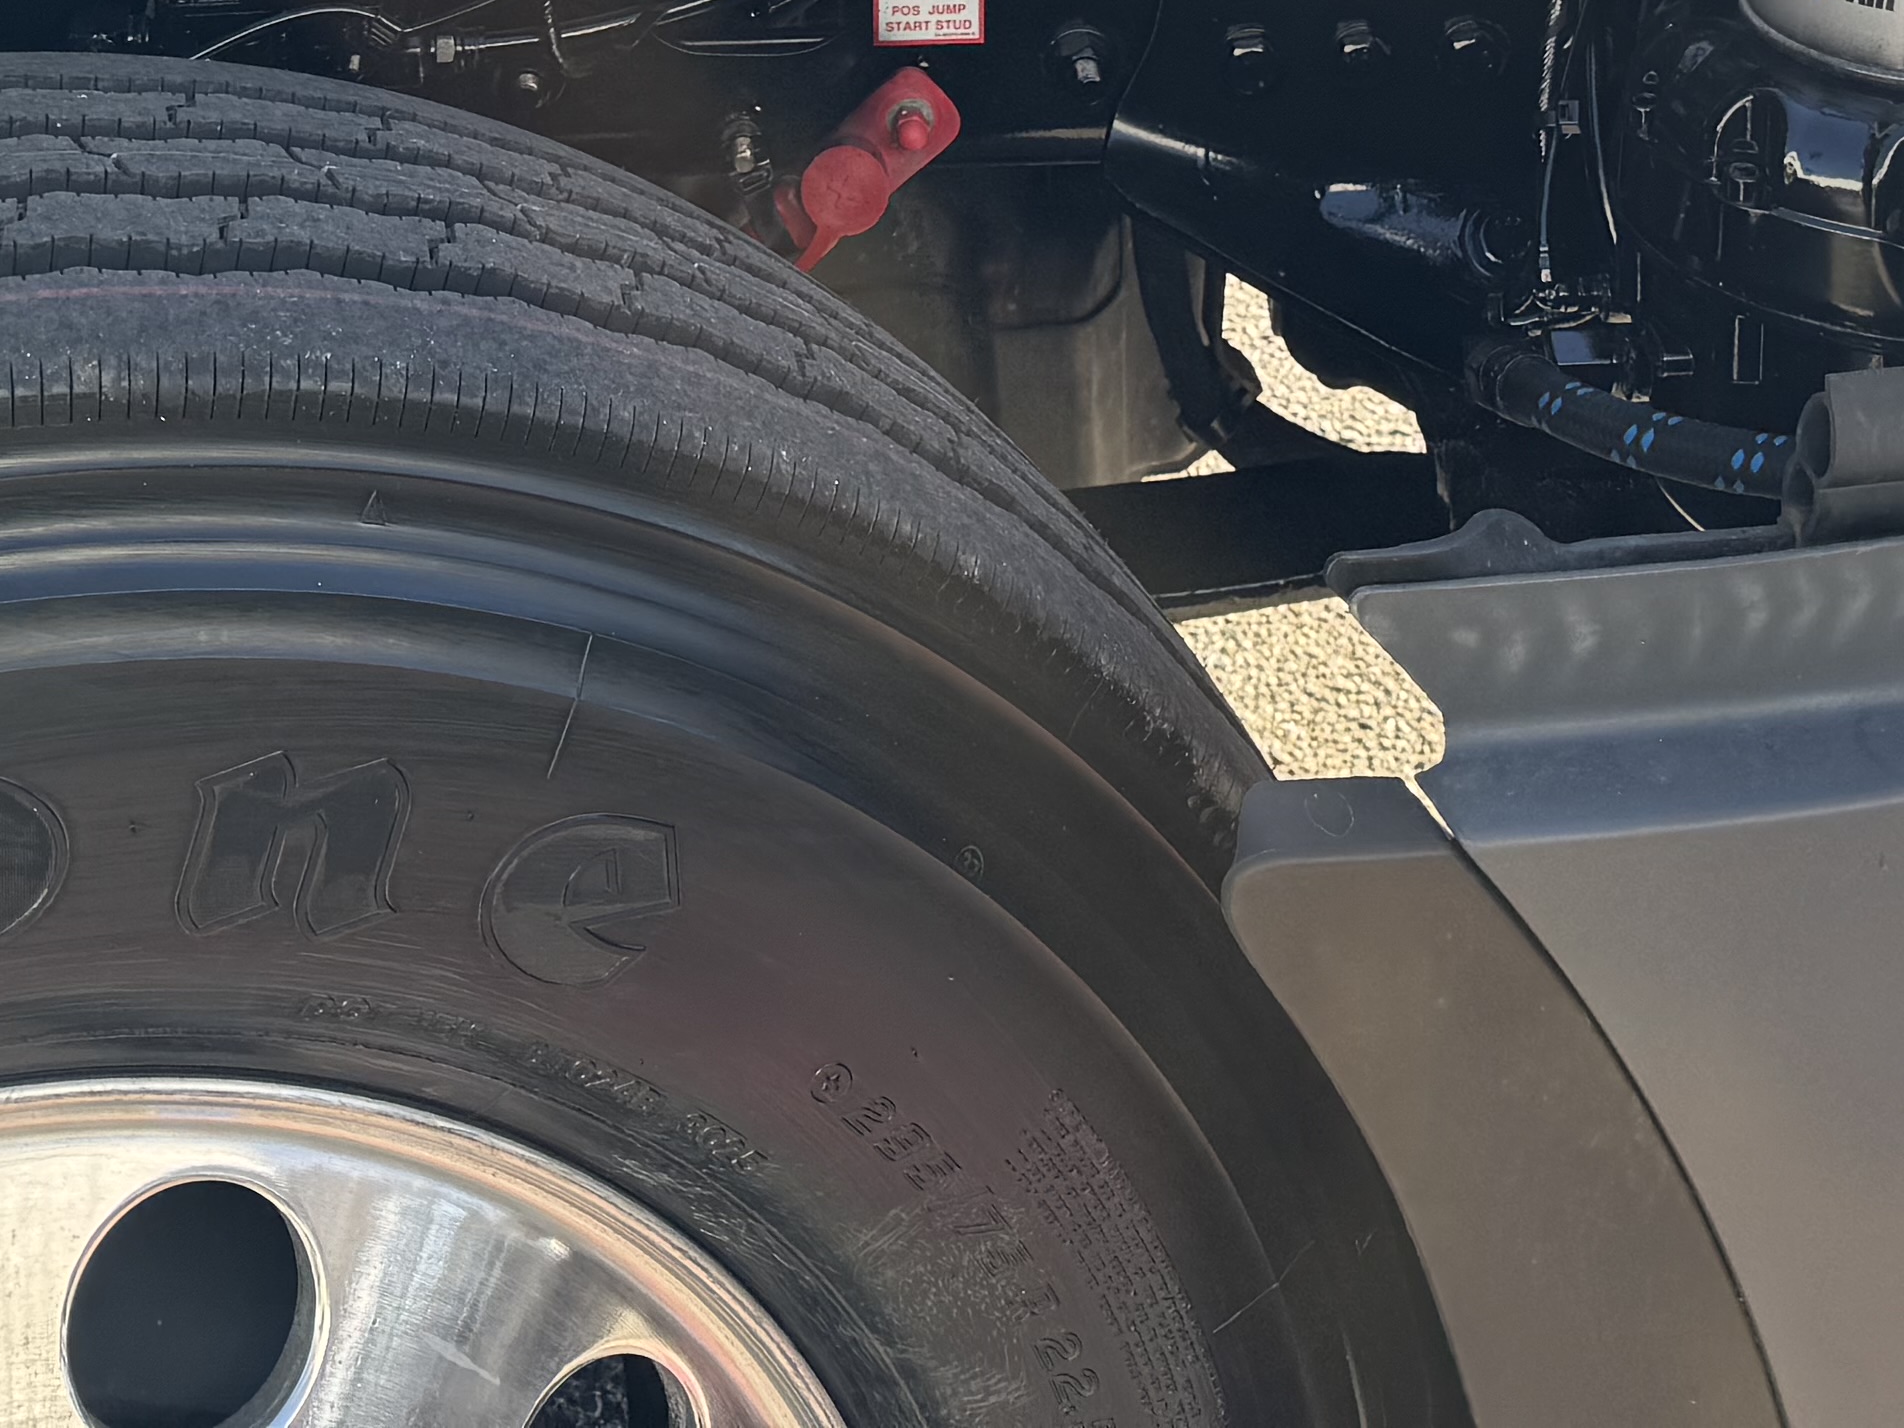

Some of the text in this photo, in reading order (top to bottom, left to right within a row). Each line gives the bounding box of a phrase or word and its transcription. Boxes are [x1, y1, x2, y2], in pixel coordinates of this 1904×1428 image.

[891, 4, 966, 16] POS JUMP
[885, 19, 973, 32] START STUD
